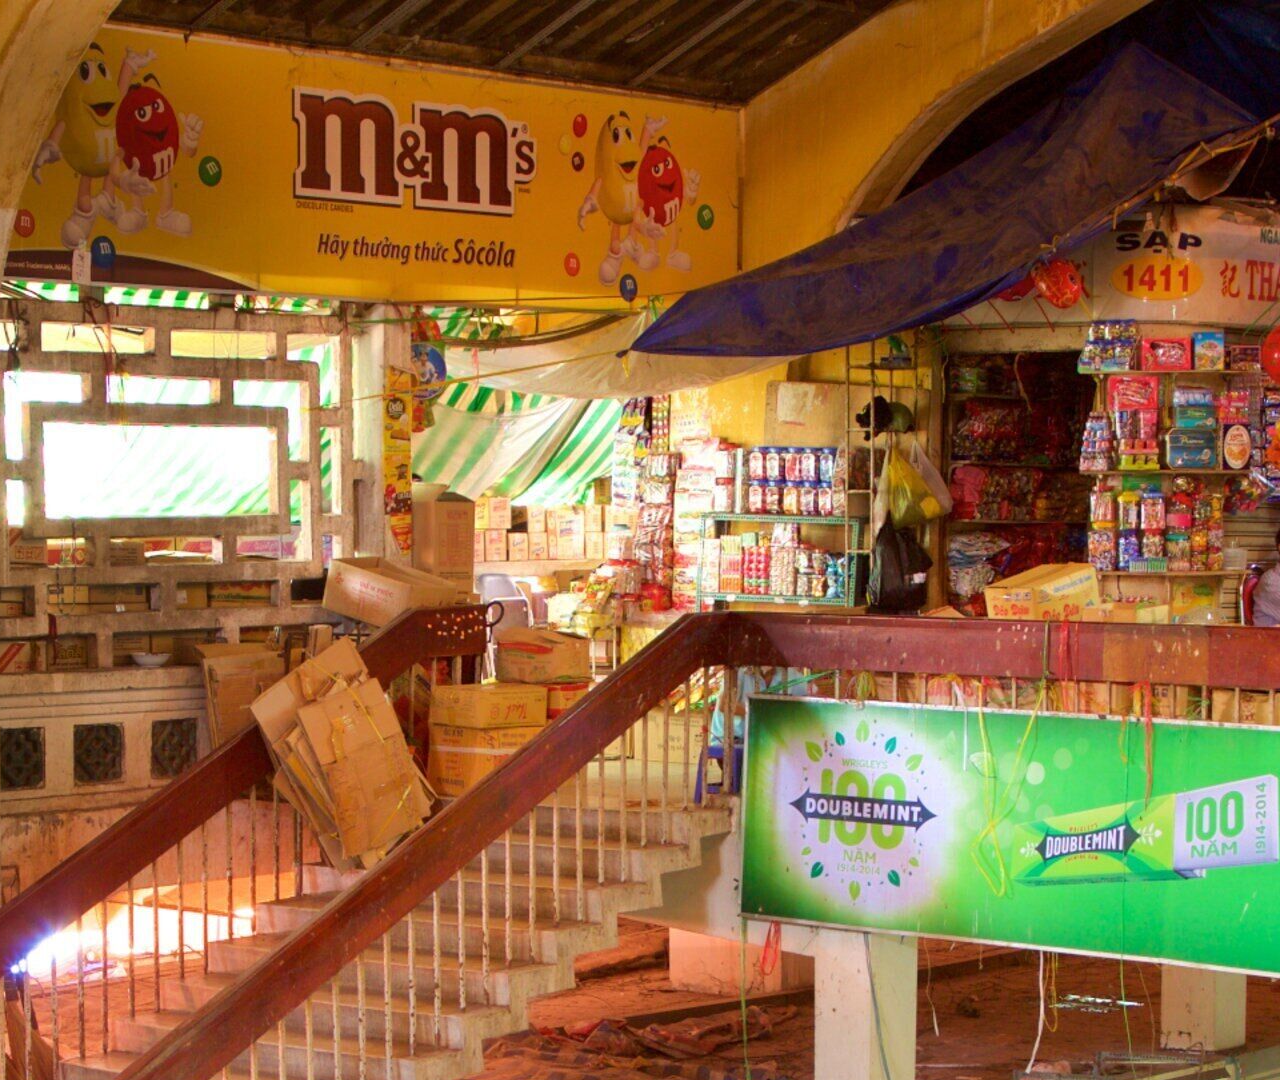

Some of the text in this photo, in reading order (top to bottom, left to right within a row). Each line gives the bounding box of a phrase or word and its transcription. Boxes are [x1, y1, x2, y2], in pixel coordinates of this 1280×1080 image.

[317, 233, 516, 268] Hãy thưởng thức Sôcôla
[1115, 231, 1202, 253] SẠP
[1122, 263, 1190, 292] 1411
[841, 757, 889, 769] WRIGLEY'S
[805, 797, 922, 823] DOUBLEMINT
[817, 768, 907, 850] 100
[1185, 790, 1245, 844] 100
[1254, 782, 1267, 855] 1914-2014
[1045, 824, 1127, 860] DOUBLEMINT
[1190, 840, 1239, 860] NĂM
[836, 863, 881, 875] 1914-2014
[842, 848, 878, 865] NĂM
